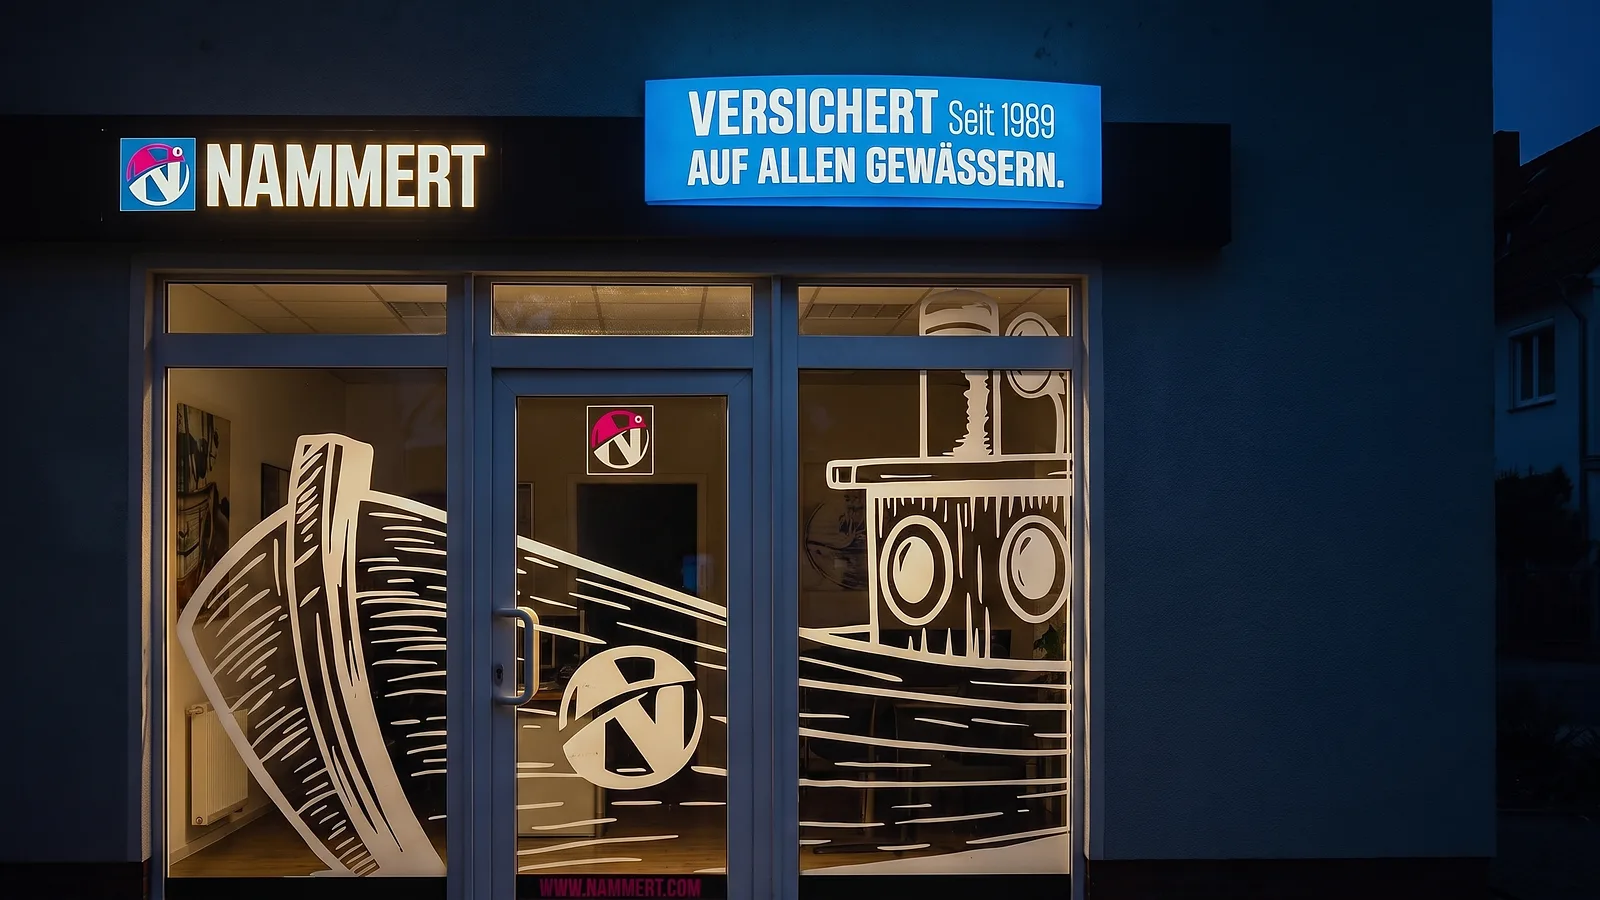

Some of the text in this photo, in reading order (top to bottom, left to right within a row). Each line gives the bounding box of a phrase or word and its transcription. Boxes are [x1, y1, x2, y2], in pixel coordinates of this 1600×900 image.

[688, 88, 1056, 139] VERSICHERT Seit 1989
[206, 143, 486, 208] NAMMERT
[687, 142, 1065, 188] AUF ALLEN GEWÄSSERN.
[539, 878, 702, 897] WWW.NAMMERT.COM
